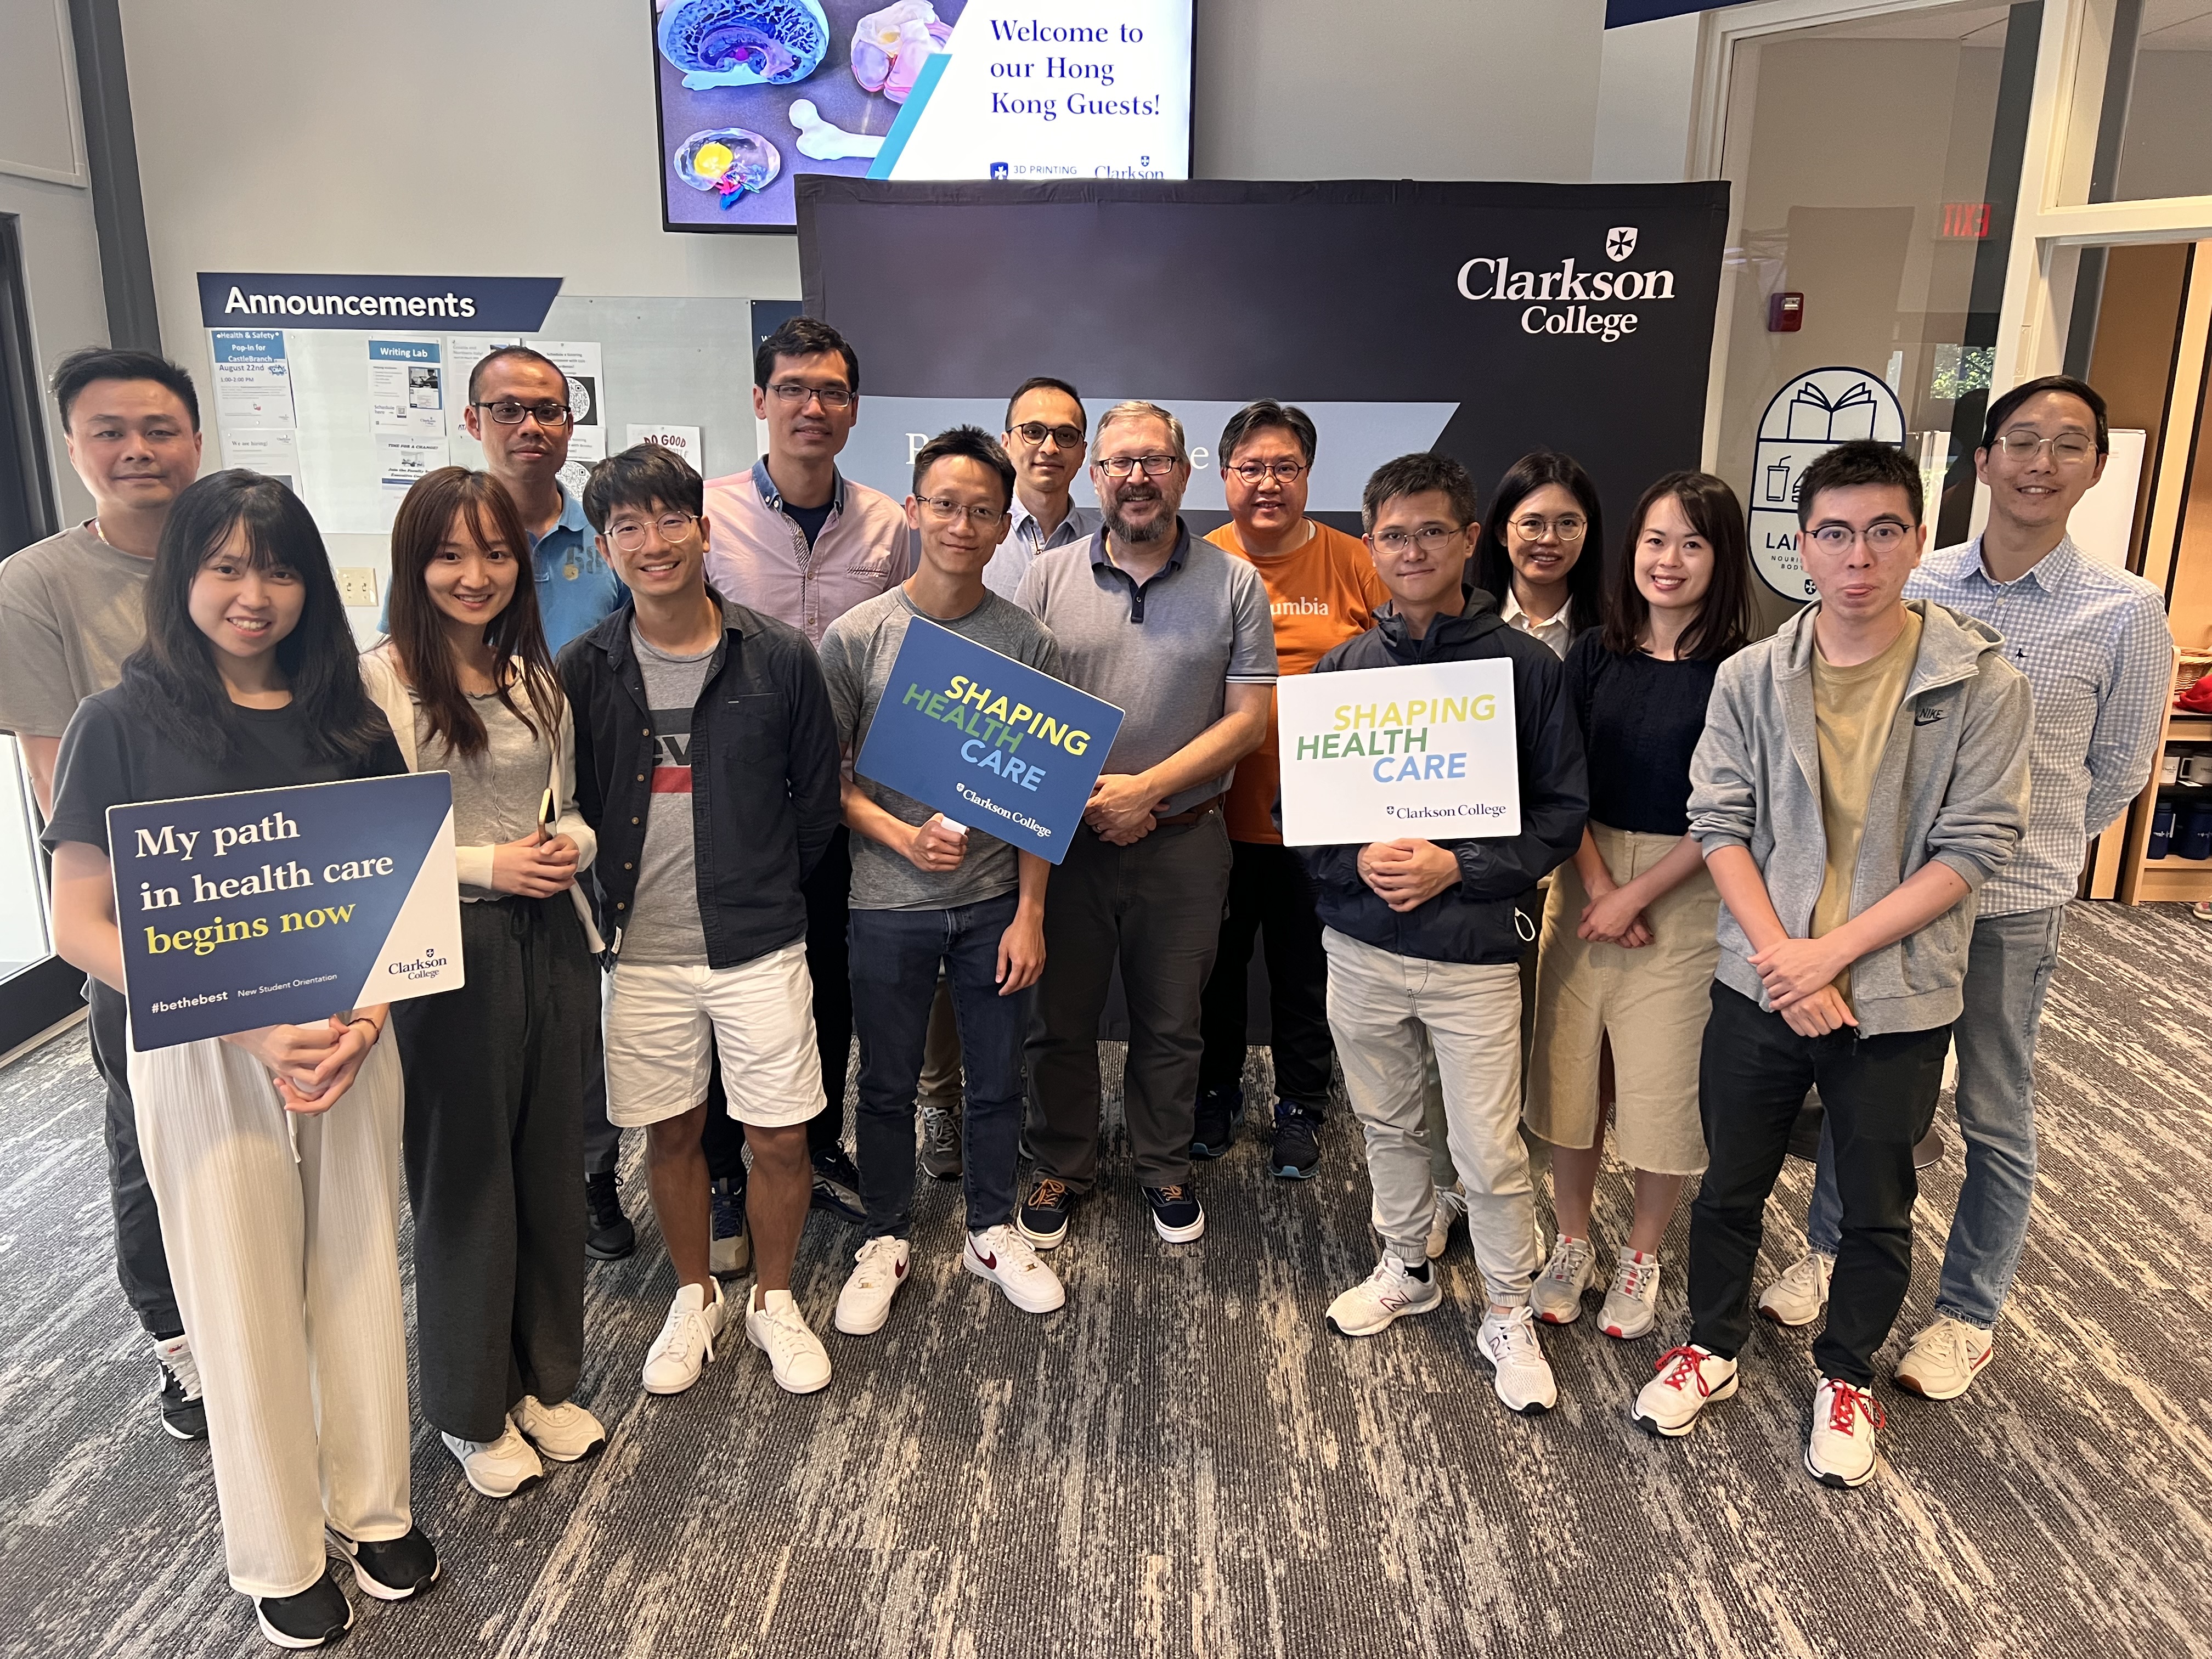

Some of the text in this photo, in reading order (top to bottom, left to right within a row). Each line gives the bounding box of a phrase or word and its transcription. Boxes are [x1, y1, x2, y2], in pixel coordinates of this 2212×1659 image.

[989, 20, 1143, 43] Welcome to
[990, 57, 1114, 86] our Hong
[991, 92, 1159, 121] Kong Guests!
[1014, 166, 1077, 174] 3D PRINTING
[1094, 165, 1164, 179] Clarkson
[1457, 257, 1675, 301] Clarkson
[224, 286, 476, 318] Announcements
[252, 331, 275, 340] Safety
[1521, 305, 1638, 343] College
[232, 344, 254, 352] Pop-In
[380, 347, 428, 358] Writing Lab
[661, 434, 686, 447] GOOD
[1270, 597, 1328, 616] umbia
[902, 682, 1025, 754] HEALTH
[944, 675, 1091, 755] SHAPING
[1333, 694, 1496, 731] SHAPING
[1919, 708, 1943, 719] NIKE
[1297, 727, 1427, 760] HEALTH
[961, 738, 1046, 792] CARE
[1373, 753, 1467, 783] CARE
[963, 788, 1051, 838] Clarkson College
[1397, 804, 1506, 819] Clarkson College
[134, 811, 301, 860] My path
[140, 856, 394, 911] in health care
[144, 904, 356, 956] begins now
[388, 957, 447, 975] Clarkson
[408, 968, 439, 980] College
[151, 973, 337, 1013] #bethebest New Student Orientation
